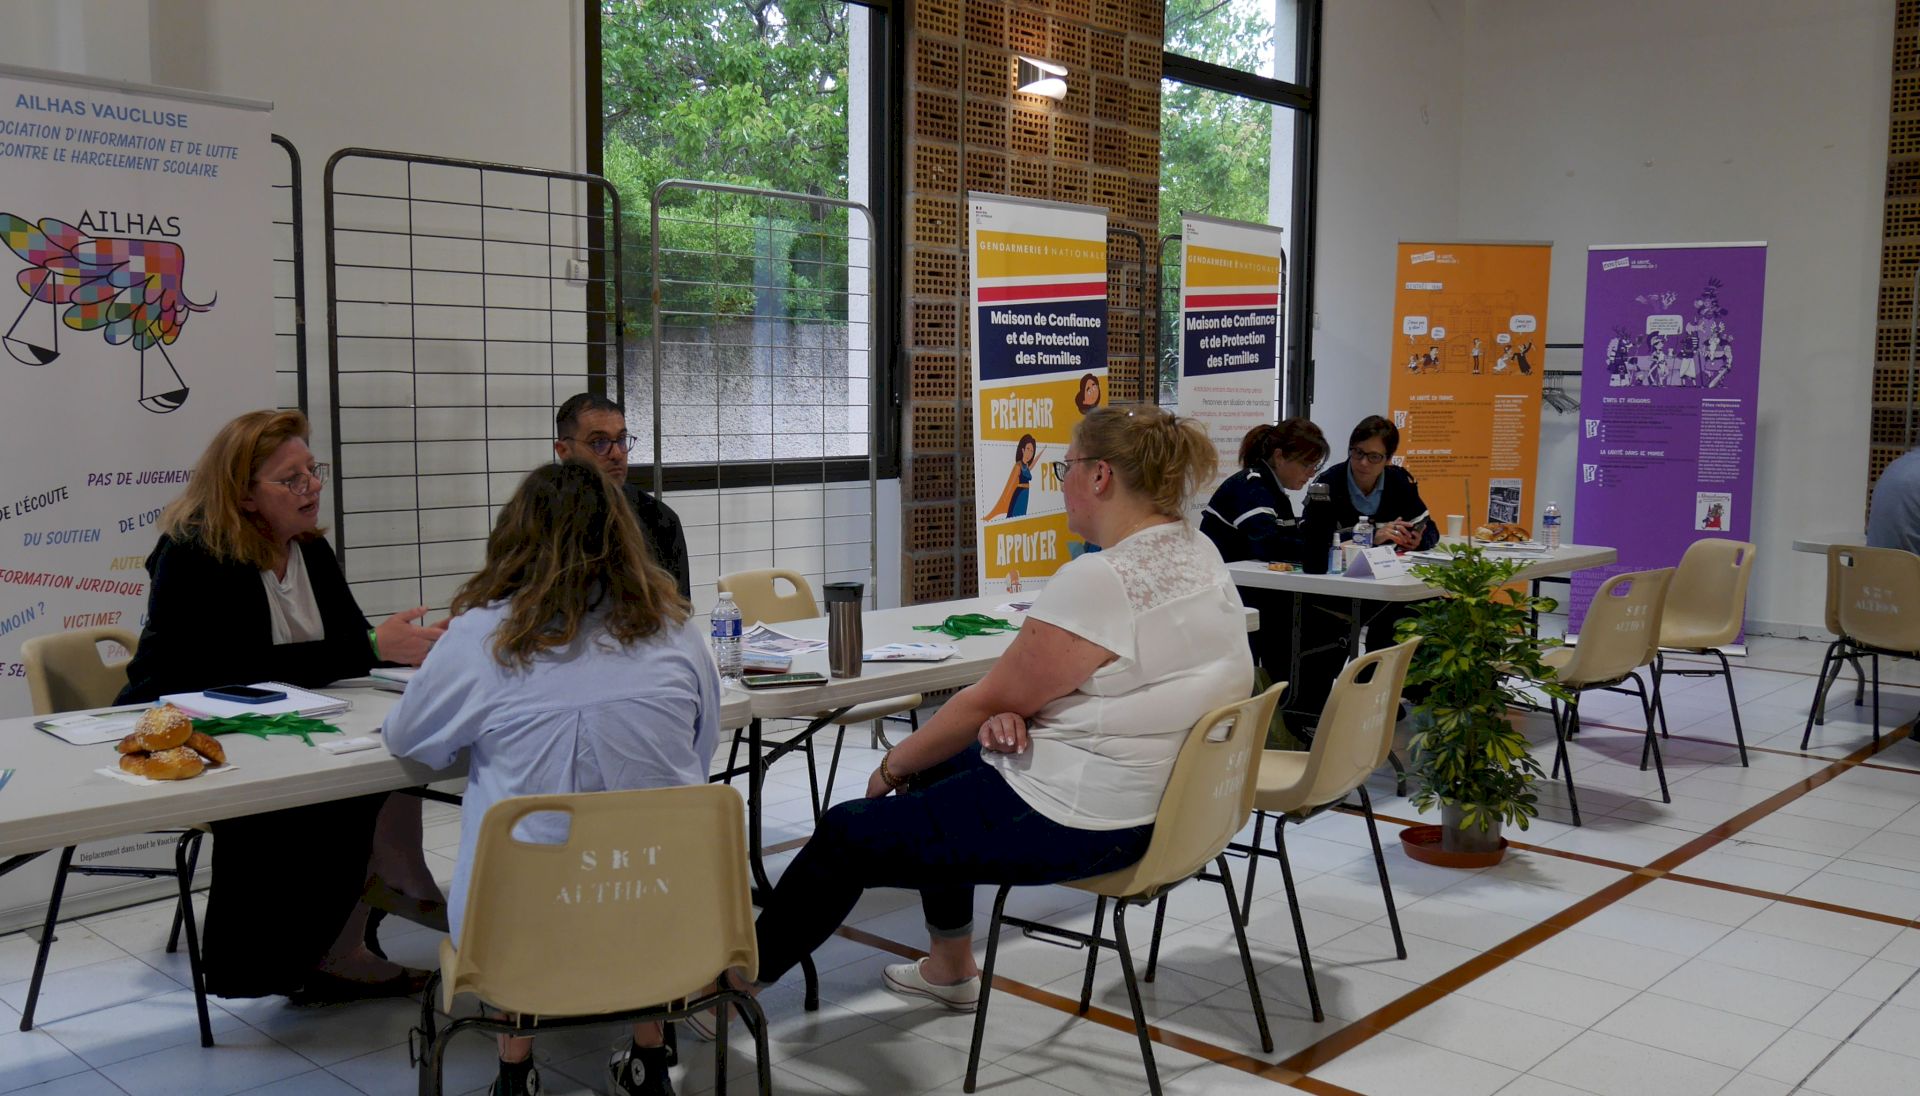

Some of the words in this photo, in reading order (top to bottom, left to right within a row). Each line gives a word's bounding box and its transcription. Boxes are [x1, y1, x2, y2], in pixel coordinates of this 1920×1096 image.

[16, 94, 85, 116] AILHAS
[91, 103, 188, 128] VAUCLUSE
[65, 128, 165, 152] D'INFORMATION
[170, 140, 183, 154] ET
[187, 142, 202, 156] DE
[206, 144, 238, 160] LUTTE
[0, 142, 49, 160] CONTRE
[53, 147, 67, 161] LE
[71, 149, 160, 172] HARCELEMENT
[163, 159, 219, 178] SCOLAIRE
[77, 209, 182, 238] AILHAS
[979, 241, 1041, 255] GENDARMERIE
[1051, 249, 1106, 261] NATIONALE
[1188, 255, 1232, 268] GENDARMERIE
[990, 310, 1033, 325] Maison
[1034, 312, 1047, 326] de
[1048, 313, 1101, 328] Confiance
[1186, 315, 1220, 331] Maison
[1220, 315, 1233, 328] de
[1234, 312, 1276, 327] Confiance
[1006, 333, 1018, 345] et
[1019, 332, 1034, 346] de
[1035, 332, 1090, 347] Protection
[1199, 336, 1210, 349] et
[1209, 335, 1221, 348] de
[1222, 331, 1266, 347] Protection
[1015, 351, 1036, 365] des
[1037, 351, 1082, 366] Familles
[1207, 354, 1223, 368] des
[1223, 350, 1260, 366] Familles
[990, 392, 1054, 430] PRÉVENIR
[88, 472, 112, 487] PAS
[117, 472, 133, 485] DE
[15, 486, 69, 516] L'ÉCOUTE
[118, 517, 135, 533] DE
[24, 532, 42, 546] DU
[46, 528, 101, 545] SOUTIEN
[996, 529, 1057, 566] APPUYER
[75, 577, 145, 596] JURIDIQUE
[38, 601, 45, 615] ?
[63, 611, 123, 629] VICTIME?
[8, 663, 26, 678] SE
[80, 848, 120, 863] Déplacement
[121, 844, 136, 854] dans
[136, 842, 149, 851] tout
[150, 840, 156, 848] le
